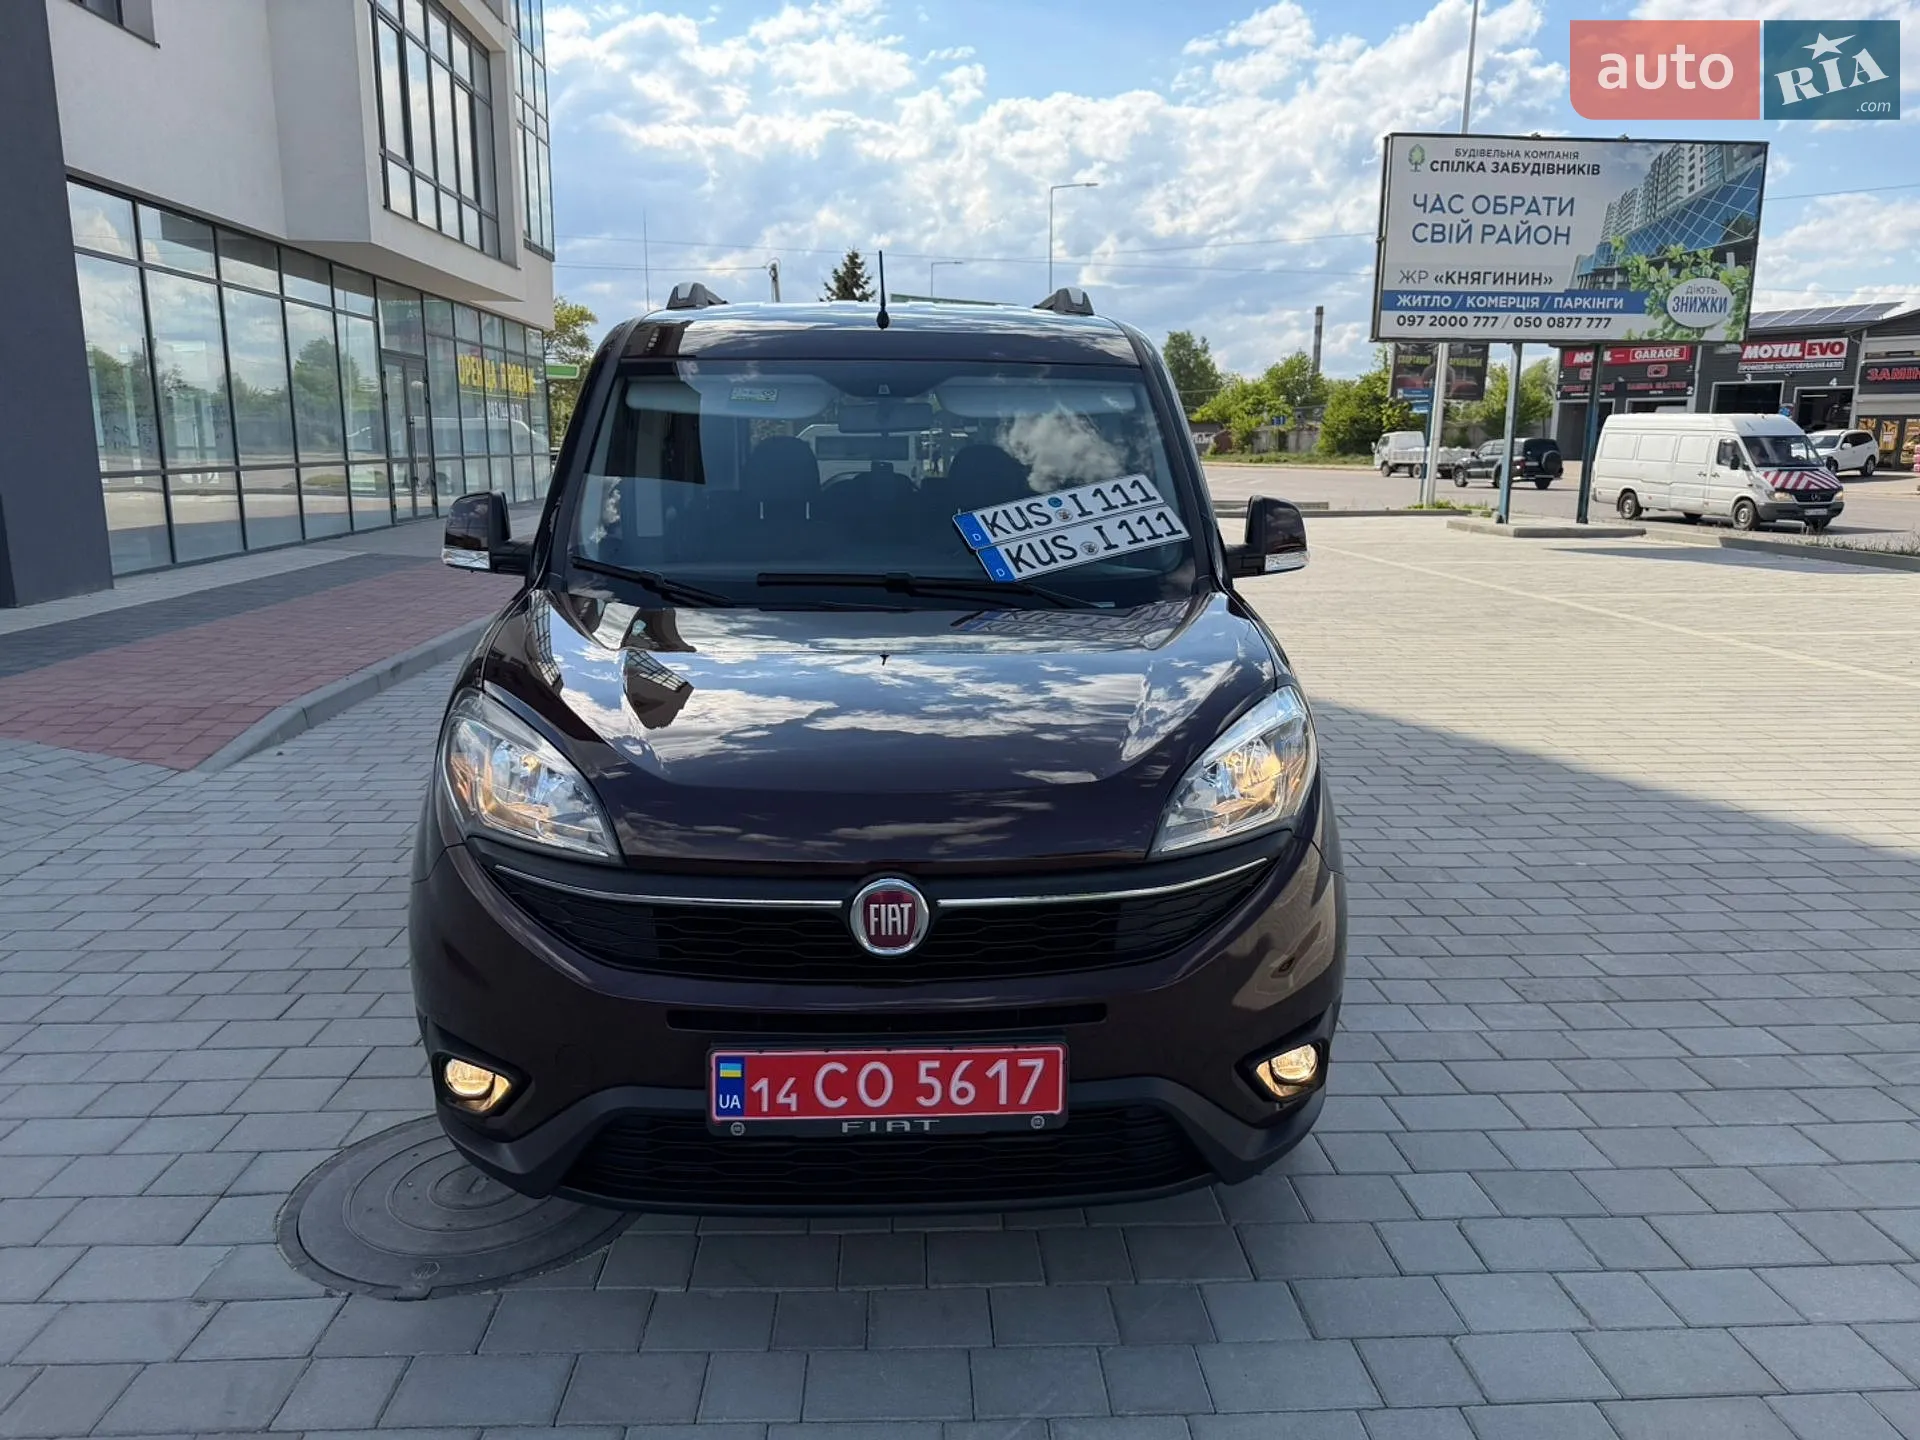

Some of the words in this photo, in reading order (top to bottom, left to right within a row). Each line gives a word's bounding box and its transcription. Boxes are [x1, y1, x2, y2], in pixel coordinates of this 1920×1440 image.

[1454, 148, 1521, 159] БУДІВЕЛЬНА
[1524, 150, 1580, 160] КОМПАНІЯ
[1429, 160, 1487, 173] СПІЛКА
[1490, 162, 1601, 176] ЗАБУДІВНИКІВ
[1412, 193, 1465, 214] ЧАС
[1472, 194, 1576, 217] ОБРАТИ
[1411, 218, 1473, 245] СВІЙ
[1481, 220, 1571, 246] РАЙОН
[1398, 269, 1429, 285] ЖР
[1433, 270, 1554, 286] «КНЯГИНИН»
[1396, 294, 1451, 308] ЖИТЛО
[1466, 295, 1540, 311] КОМЕРЦІЯ
[1553, 297, 1625, 310] ПАРКІНГИ
[1672, 295, 1728, 313] ЗНИЖКИ
[1396, 314, 1425, 327] 097
[1428, 315, 1468, 328] 2000
[1472, 316, 1499, 328] 777
[1513, 316, 1543, 328] 050
[1546, 317, 1582, 329] 0877
[1586, 317, 1612, 329] 777
[1634, 348, 1681, 360] GARAGE
[1742, 343, 1803, 359] MOTUL
[1806, 341, 1845, 357] EVO
[1829, 377, 1838, 386] 4
[1686, 386, 1694, 395] 2
[980, 502, 1053, 538] KUS
[1092, 479, 1158, 512] 111
[972, 533, 982, 542] D
[1004, 534, 1079, 573] KUS
[1117, 511, 1183, 545] 111
[995, 568, 1006, 577] D
[869, 902, 913, 936] FIAT
[751, 1076, 798, 1112] 14
[813, 1061, 894, 1109] CO
[915, 1058, 1046, 1107] 5617
[718, 1094, 741, 1110] UA
[841, 1119, 940, 1133] FIAT
